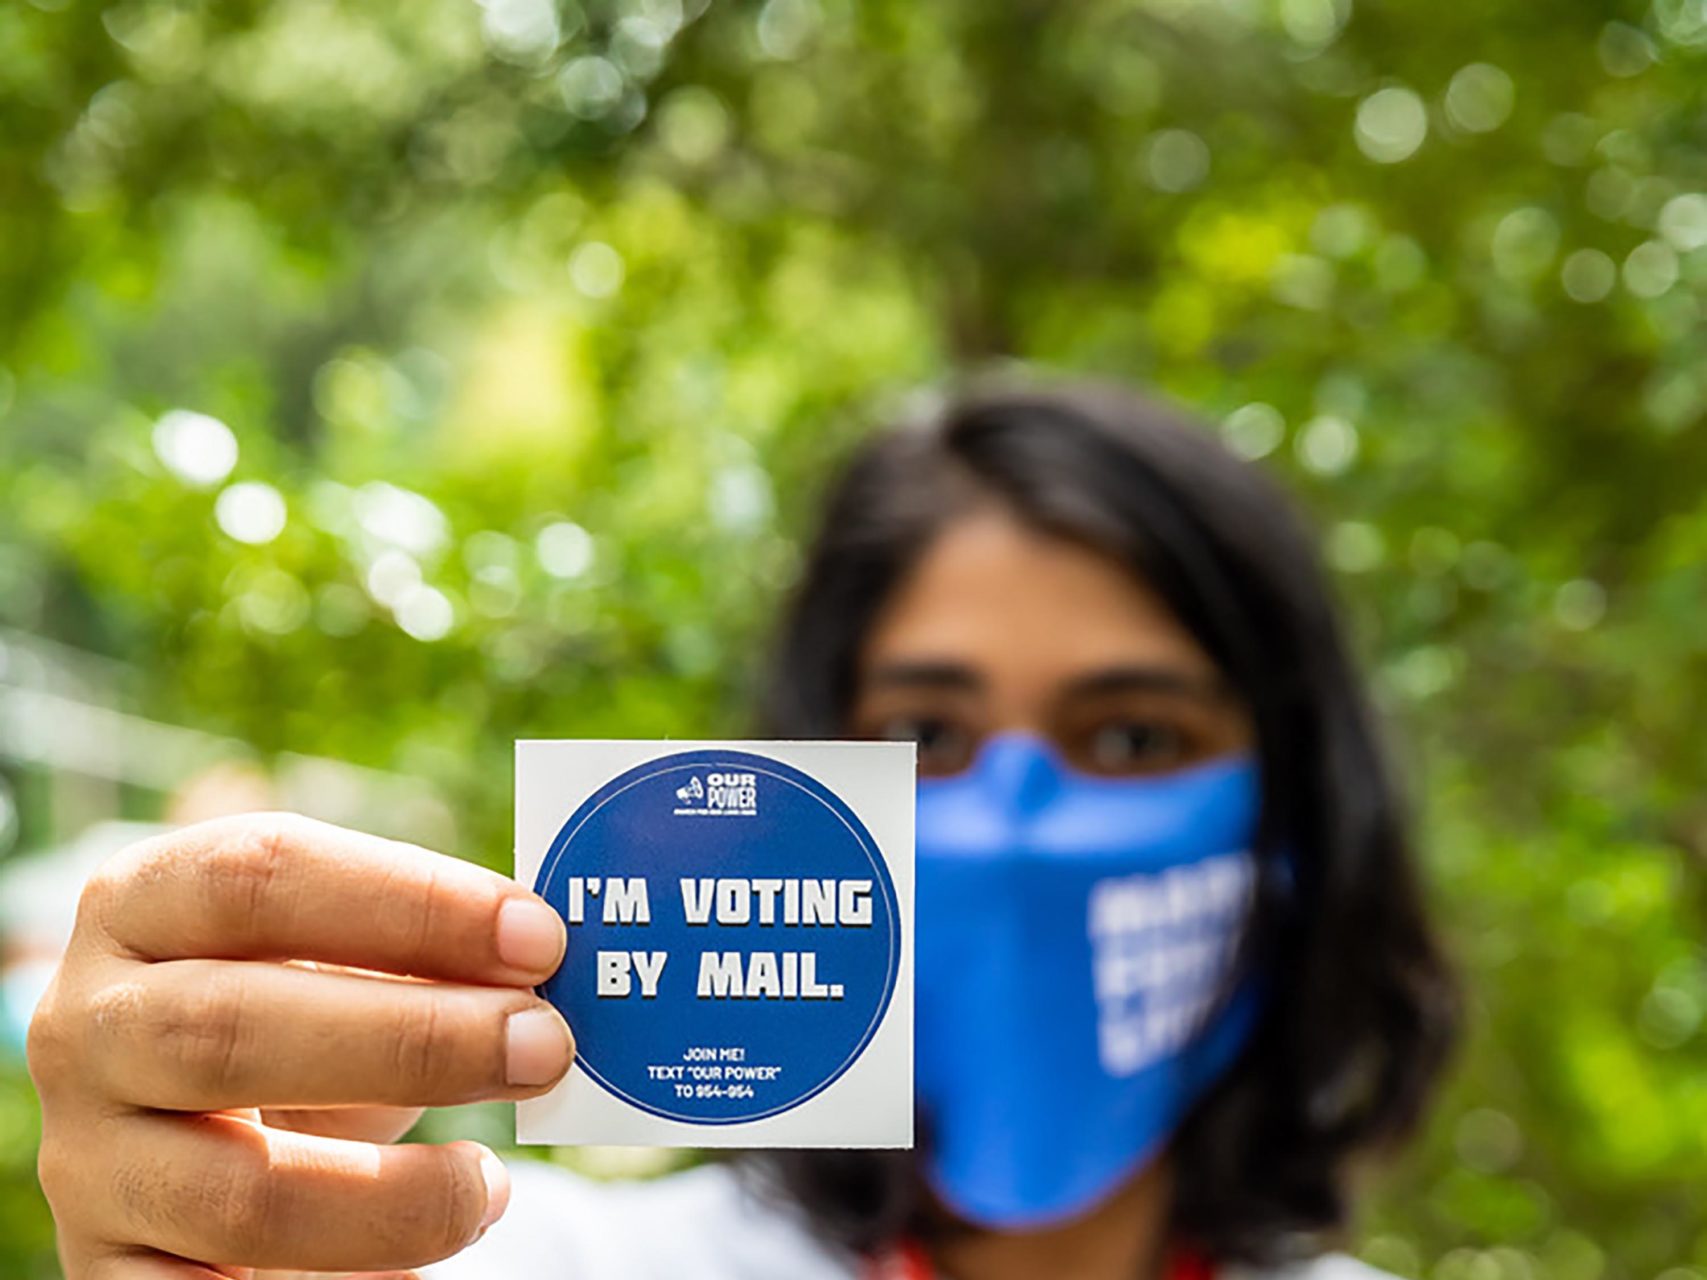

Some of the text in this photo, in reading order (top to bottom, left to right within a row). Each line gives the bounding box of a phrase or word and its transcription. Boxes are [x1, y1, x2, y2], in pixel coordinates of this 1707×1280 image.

[707, 773, 756, 786] OUR
[707, 786, 756, 808] POWER
[568, 877, 873, 926] I'M VOTING
[597, 951, 845, 999] BY MAIL.
[683, 1047, 745, 1061] JOIN ME!
[647, 1065, 685, 1080] TEXT
[674, 1083, 694, 1098] TO
